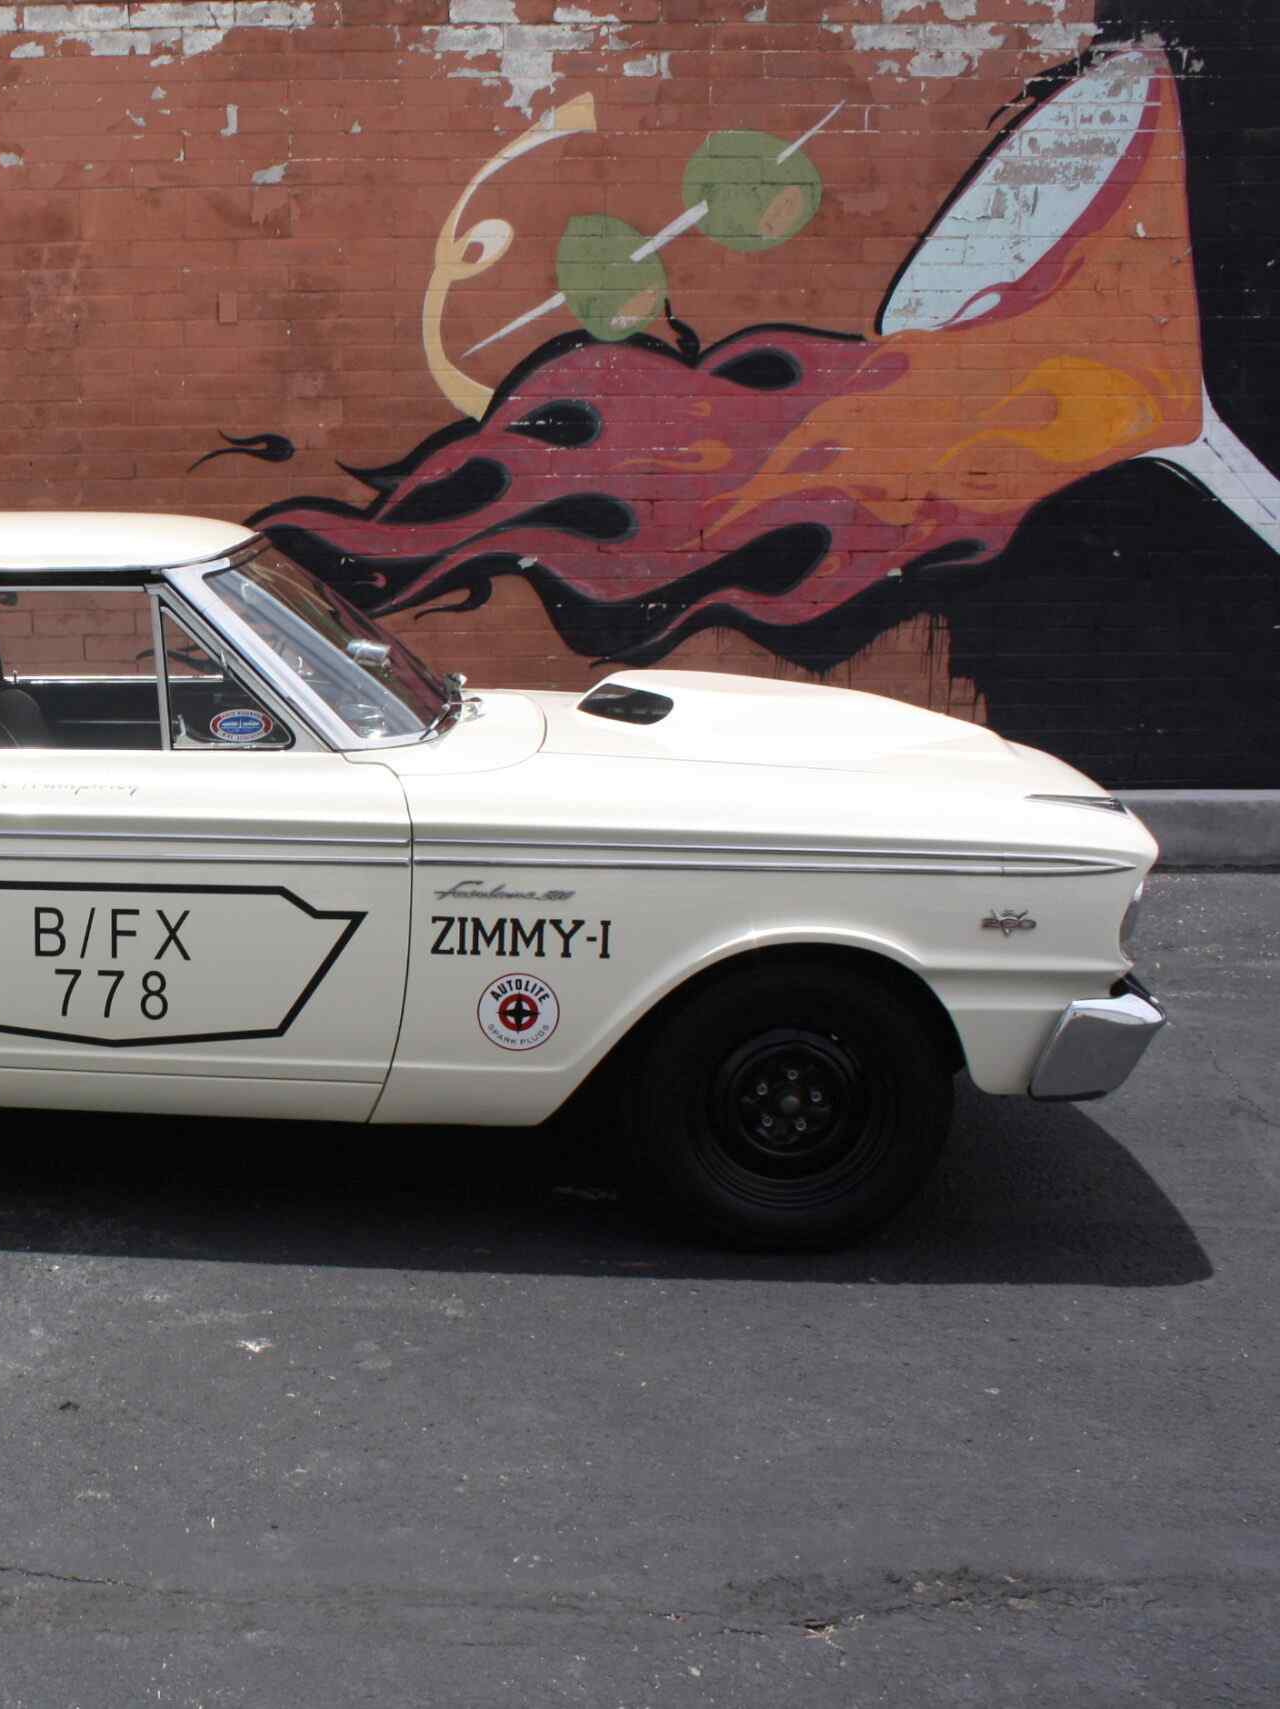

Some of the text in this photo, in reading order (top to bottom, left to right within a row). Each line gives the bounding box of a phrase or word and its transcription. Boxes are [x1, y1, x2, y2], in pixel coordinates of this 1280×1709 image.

[34, 906, 192, 961] B/FX
[430, 915, 612, 959] ZIMMY-I
[54, 968, 169, 1021] 778
[490, 978, 550, 1002] AUTOLITE
[487, 1023, 550, 1045] SPARK PLUGS
